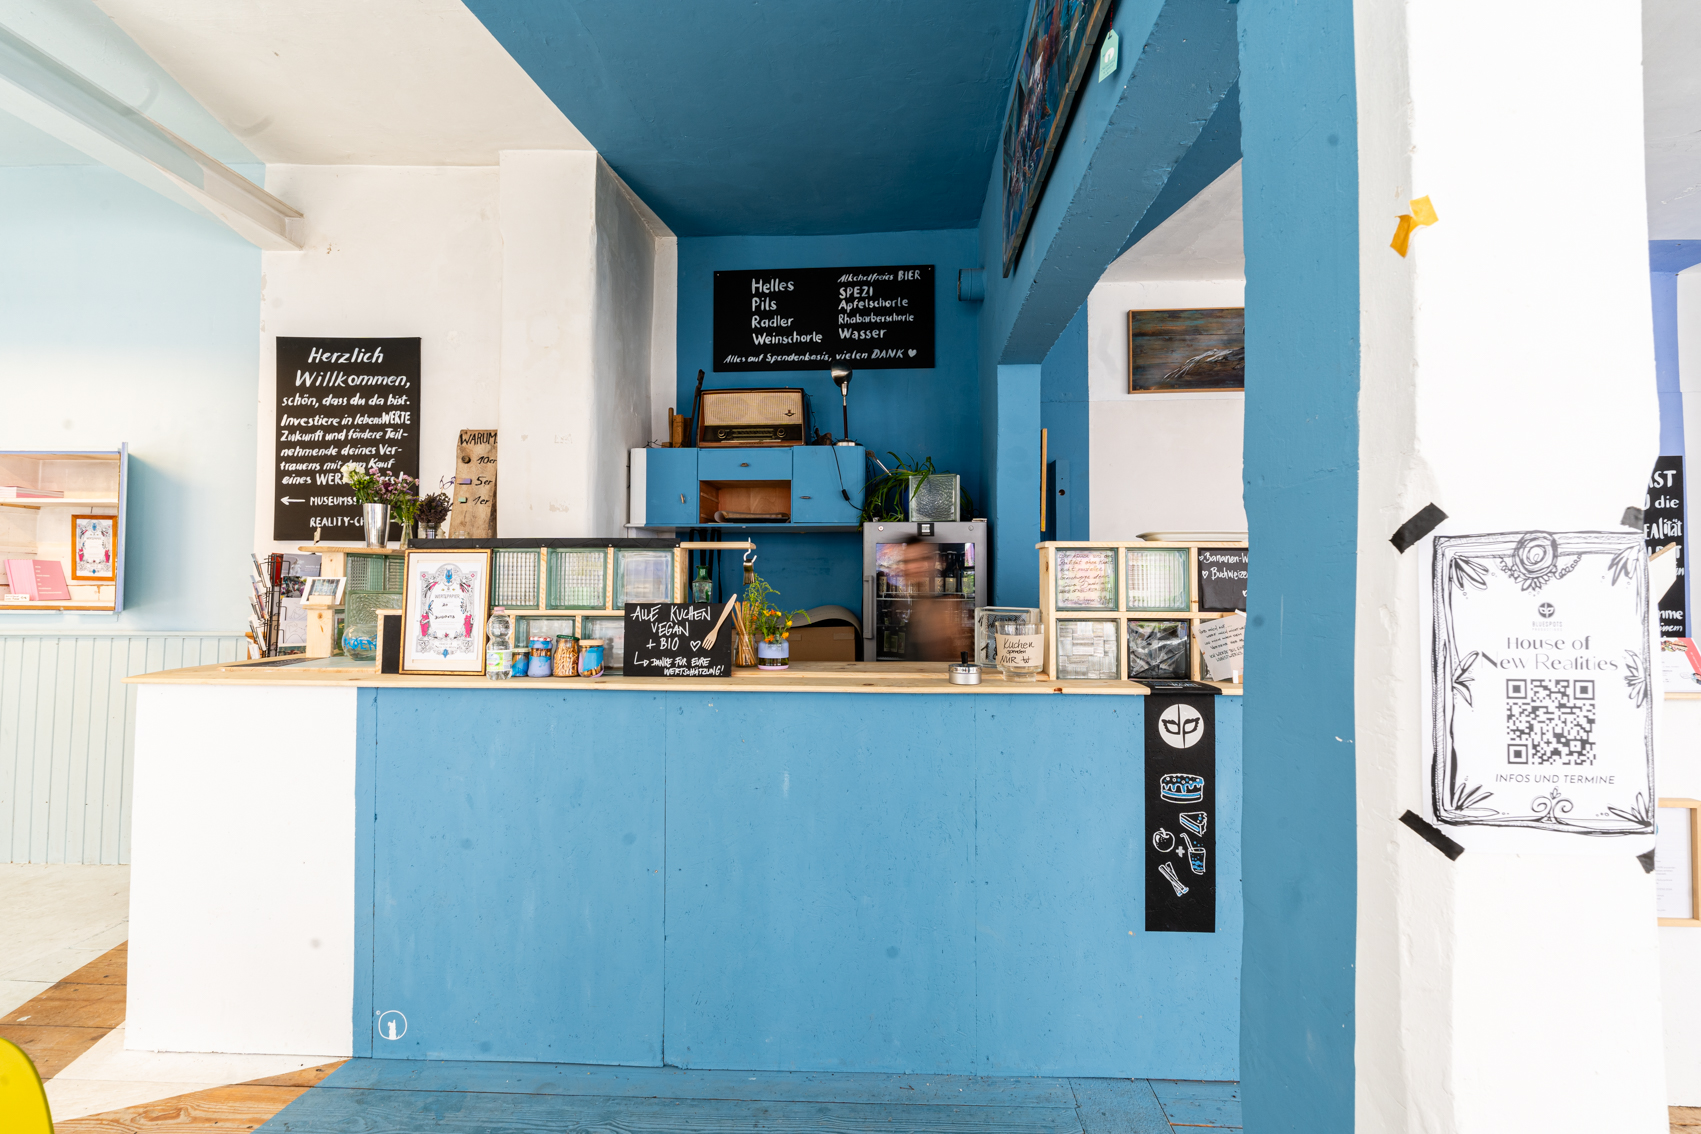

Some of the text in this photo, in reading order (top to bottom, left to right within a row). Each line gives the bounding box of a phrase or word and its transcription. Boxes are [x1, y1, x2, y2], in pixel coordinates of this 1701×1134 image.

[897, 270, 921, 282] BIER
[751, 278, 795, 294] Helles
[839, 285, 874, 299] SPEZI
[751, 297, 777, 312] Pils
[838, 297, 909, 313] Apfelschorle
[751, 315, 795, 329] Radler
[838, 312, 915, 325] Rhabarberschorle
[752, 330, 823, 346] Weinschorle
[839, 328, 887, 340] Wasser
[308, 347, 384, 363] Herzlich
[723, 348, 904, 364] Alles auf Spendenbasis, vielen DANK
[295, 370, 411, 388] Willkommen,
[281, 393, 411, 408] schön, dass du da bist.
[280, 411, 411, 427] Investiere in lebensWERTE
[280, 427, 409, 442] Zukunft und fördere Teil-
[280, 443, 403, 457] nehmende deines Ver-
[280, 460, 321, 471] trauens
[323, 459, 344, 471] mit
[368, 457, 396, 469] Kauf
[477, 456, 497, 465] 10er
[282, 474, 312, 485] eines
[475, 476, 493, 486] 5er
[473, 496, 491, 505] 1er
[1654, 494, 1680, 509] die
[630, 604, 711, 622] ALLE KUCHEN
[651, 621, 689, 637] VEGAN
[660, 637, 679, 650] BIO
[1003, 638, 1034, 650] Kuchen
[1507, 635, 1591, 650] House of
[650, 657, 673, 667] DANKE
[691, 657, 711, 667] EURE
[1481, 651, 1618, 671] New Realities
[1495, 773, 1615, 785] INFOS UND TERMINE
